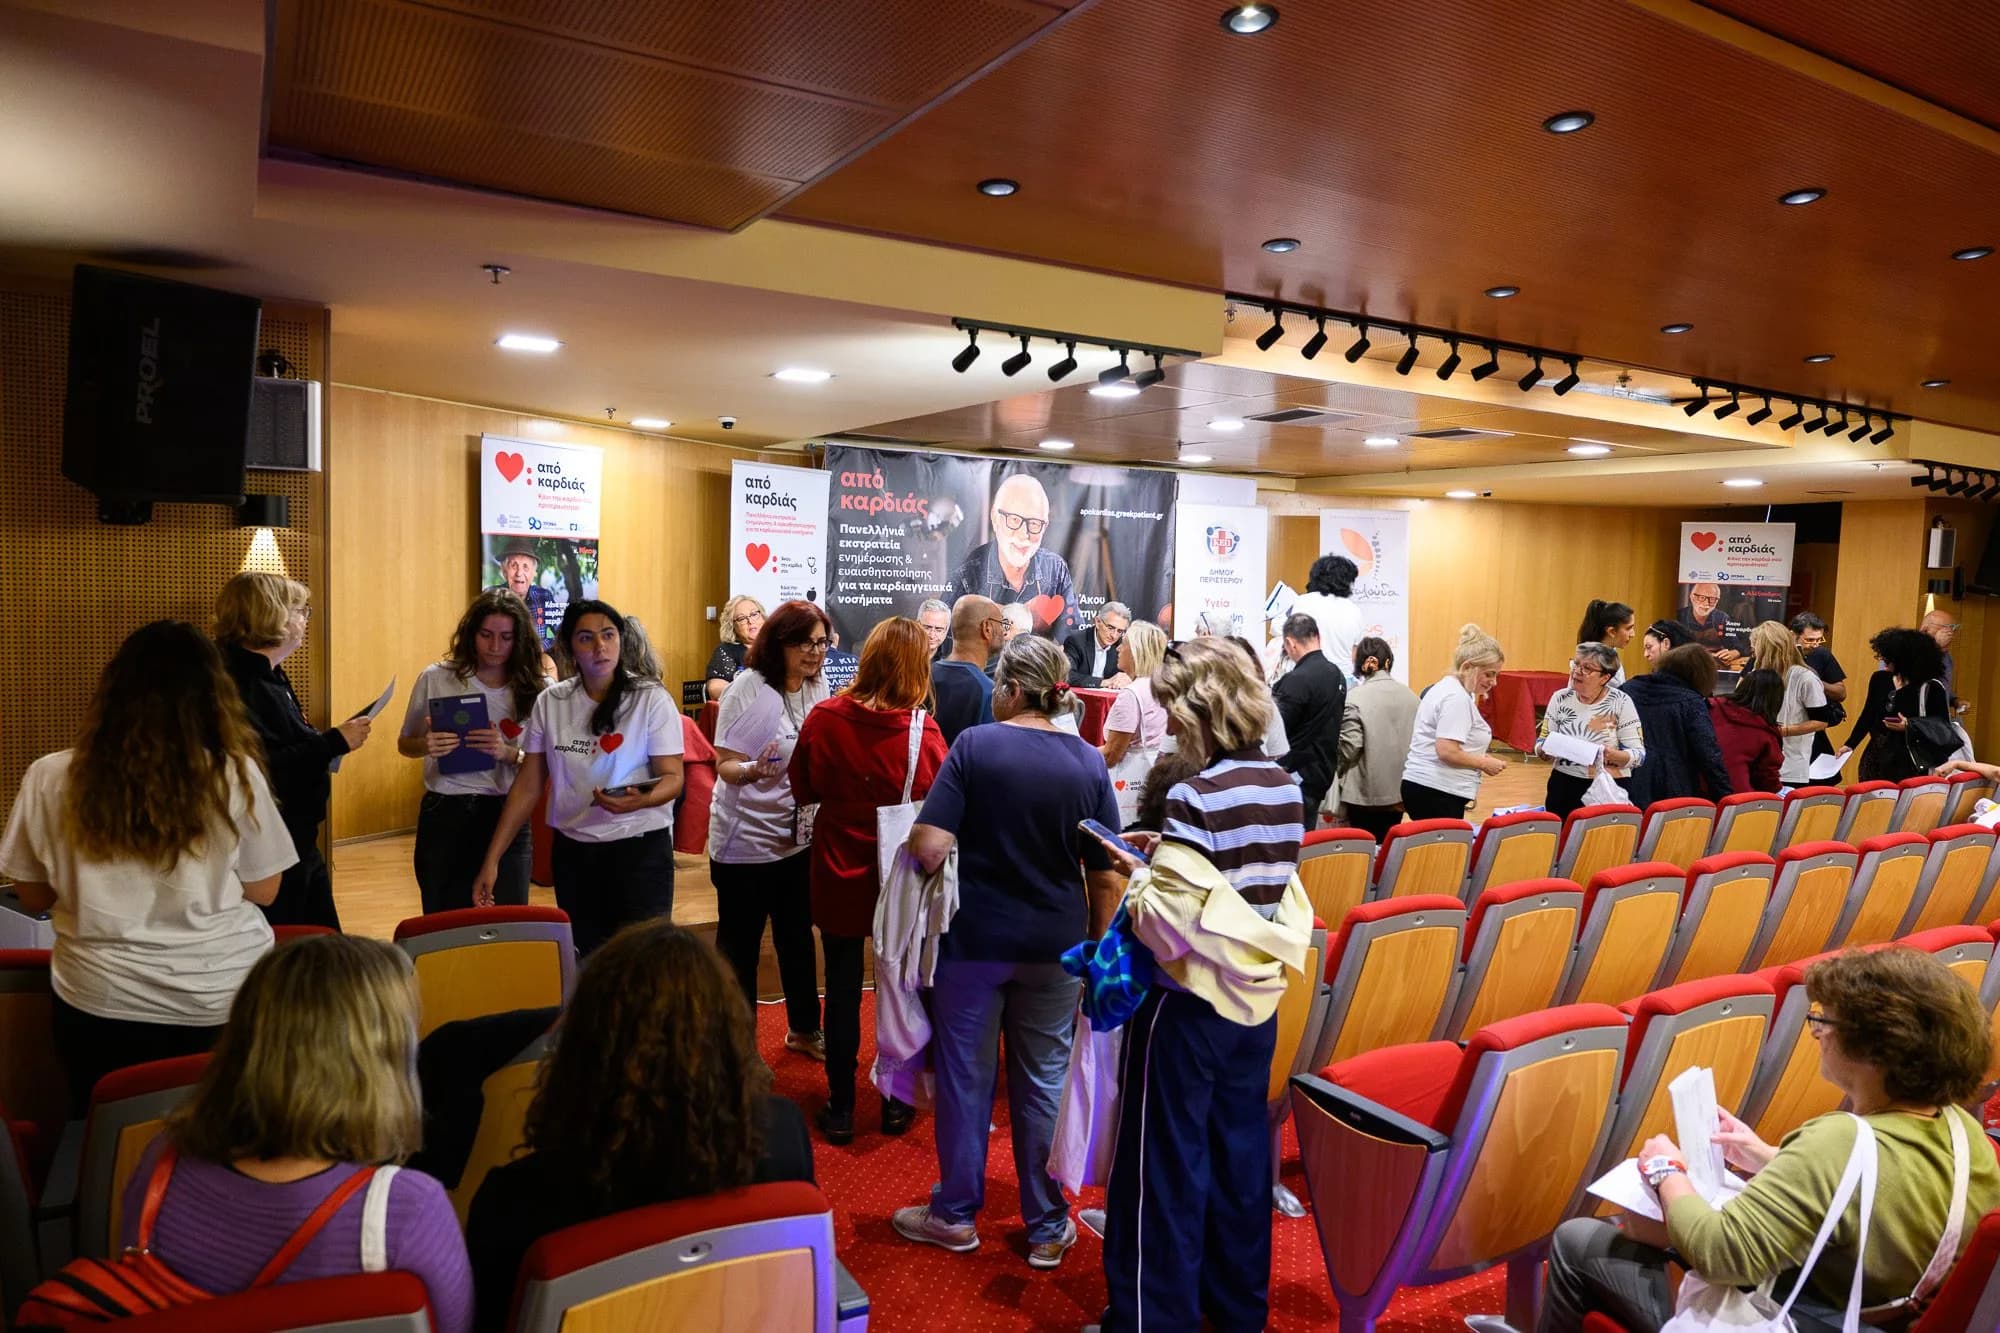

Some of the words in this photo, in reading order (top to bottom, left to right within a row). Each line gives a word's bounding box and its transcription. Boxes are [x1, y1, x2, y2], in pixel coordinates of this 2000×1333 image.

[136, 317, 160, 424] PROEL
[537, 461, 561, 474] από
[745, 475, 771, 489] από
[841, 467, 884, 489] από
[538, 477, 586, 494] καρδιάς
[745, 492, 798, 511] καρδιάς
[841, 491, 929, 520] καρδιάς
[840, 524, 905, 537] Πανελλήνια
[839, 539, 901, 550] εκστρατεία
[1728, 534, 1752, 544] από
[1728, 544, 1775, 556] καρδιάς
[839, 552, 904, 566] ενημέρωσης
[905, 555, 913, 564] &
[838, 567, 932, 580] ευαισθητοποίησης
[838, 581, 857, 592] για
[873, 581, 953, 594] καρδιαγγειακά
[838, 594, 893, 606] νοσήματα
[1079, 593, 1105, 604] Άκου
[1080, 610, 1097, 620] την
[573, 739, 591, 747] από
[555, 745, 589, 755] καρδιάς
